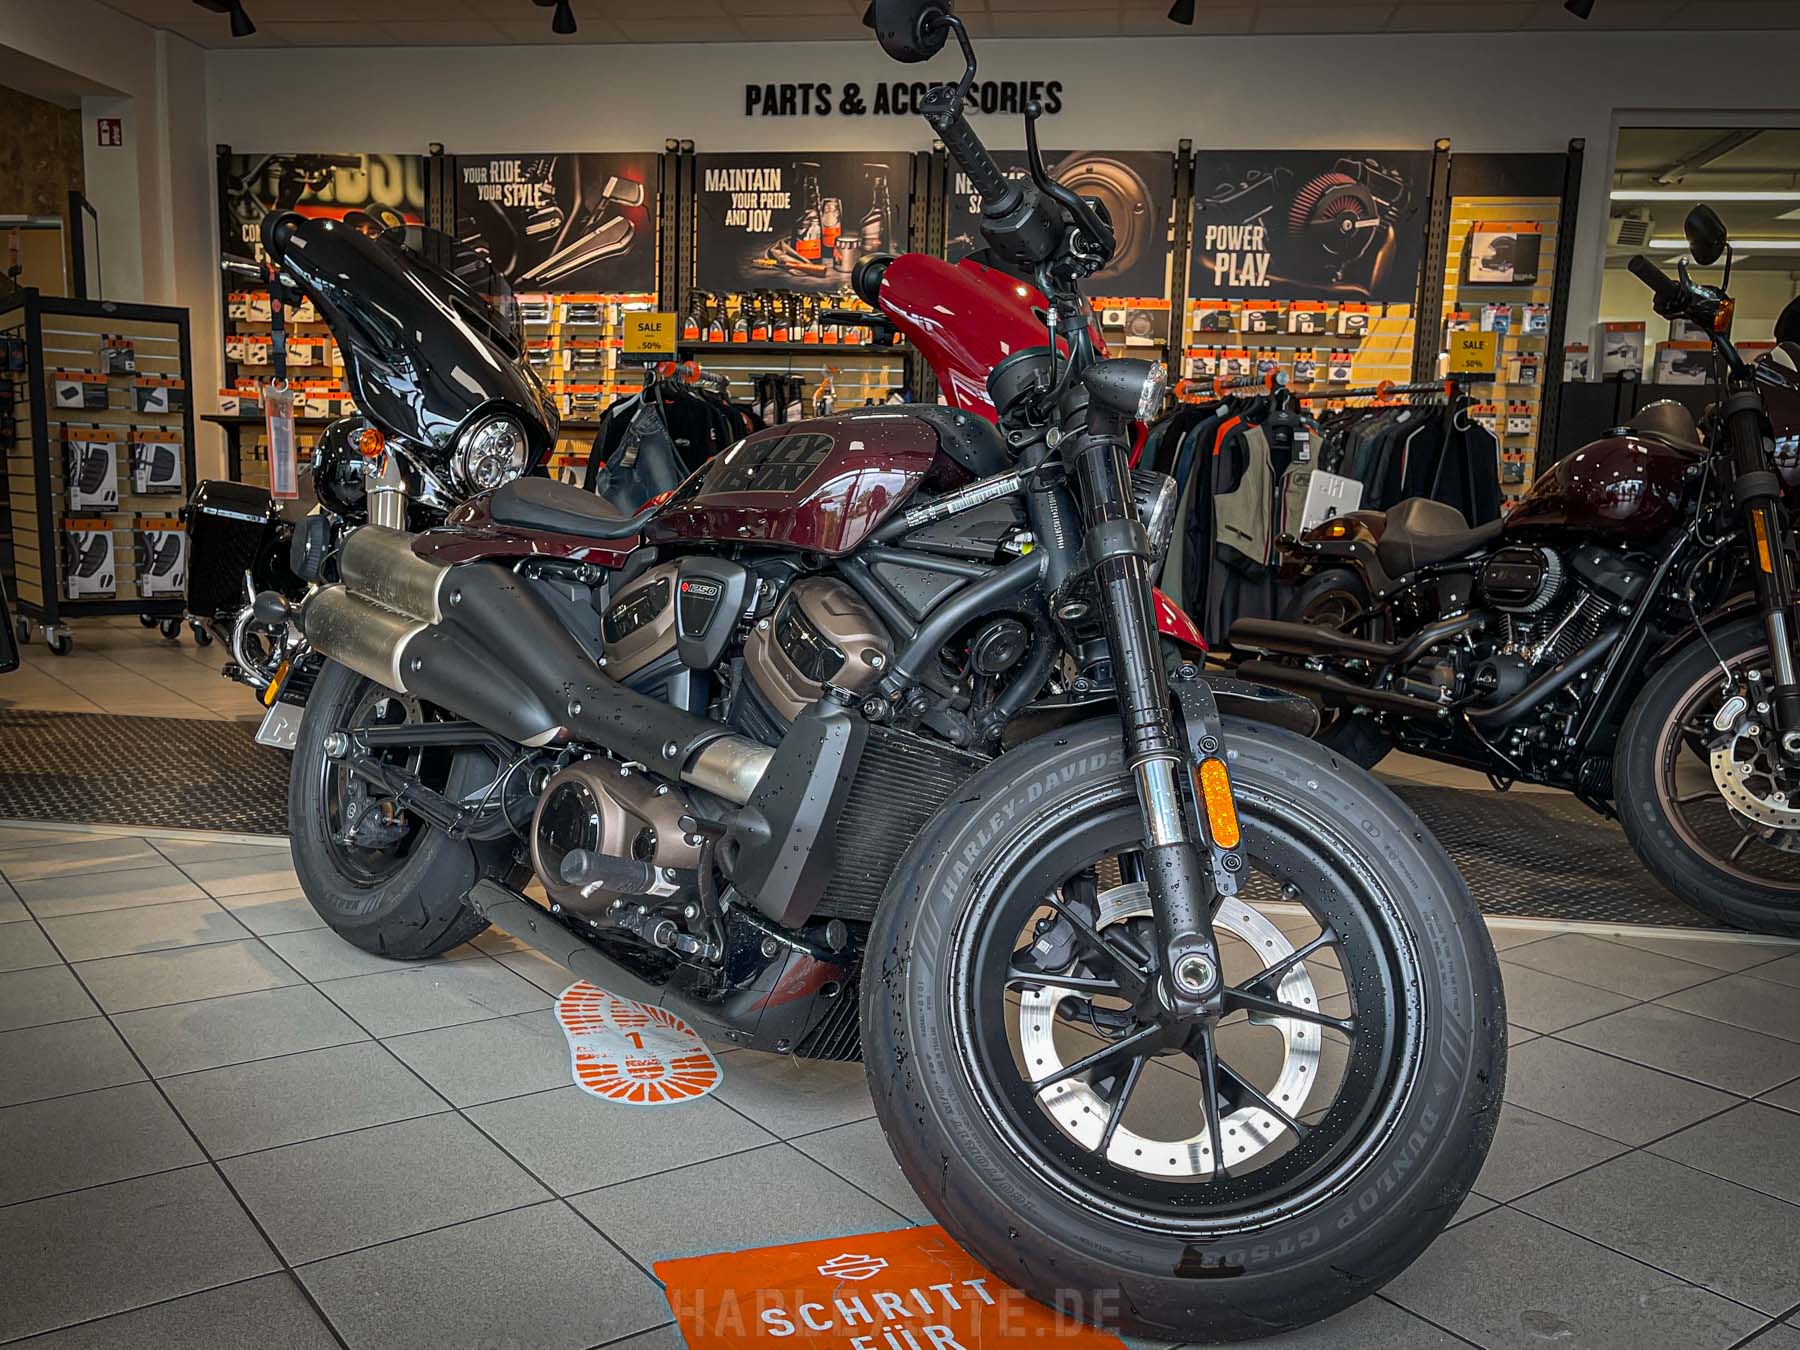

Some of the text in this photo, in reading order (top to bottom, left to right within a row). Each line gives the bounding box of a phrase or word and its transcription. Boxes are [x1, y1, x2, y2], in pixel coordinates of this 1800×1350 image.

[744, 81, 1063, 116] PARTS & ACCSORIES
[463, 160, 526, 183] YOUR RIDE.
[704, 168, 782, 192] MAINTAIN
[477, 183, 546, 207] YOUR STYLE.
[731, 192, 791, 209] YOUR PRIDE
[725, 209, 773, 232] AND JOY.
[1205, 225, 1265, 251] POWER
[1214, 252, 1271, 287] PLAY.
[637, 322, 662, 332] SALE
[1463, 340, 1485, 350] SALE
[688, 583, 718, 596] 1250
[939, 747, 1122, 902] HARLEY-DAVIDS
[624, 1031, 644, 1050] 1
[1330, 1101, 1442, 1231] DUNLOP
[760, 1278, 996, 1337] SCHRITT
